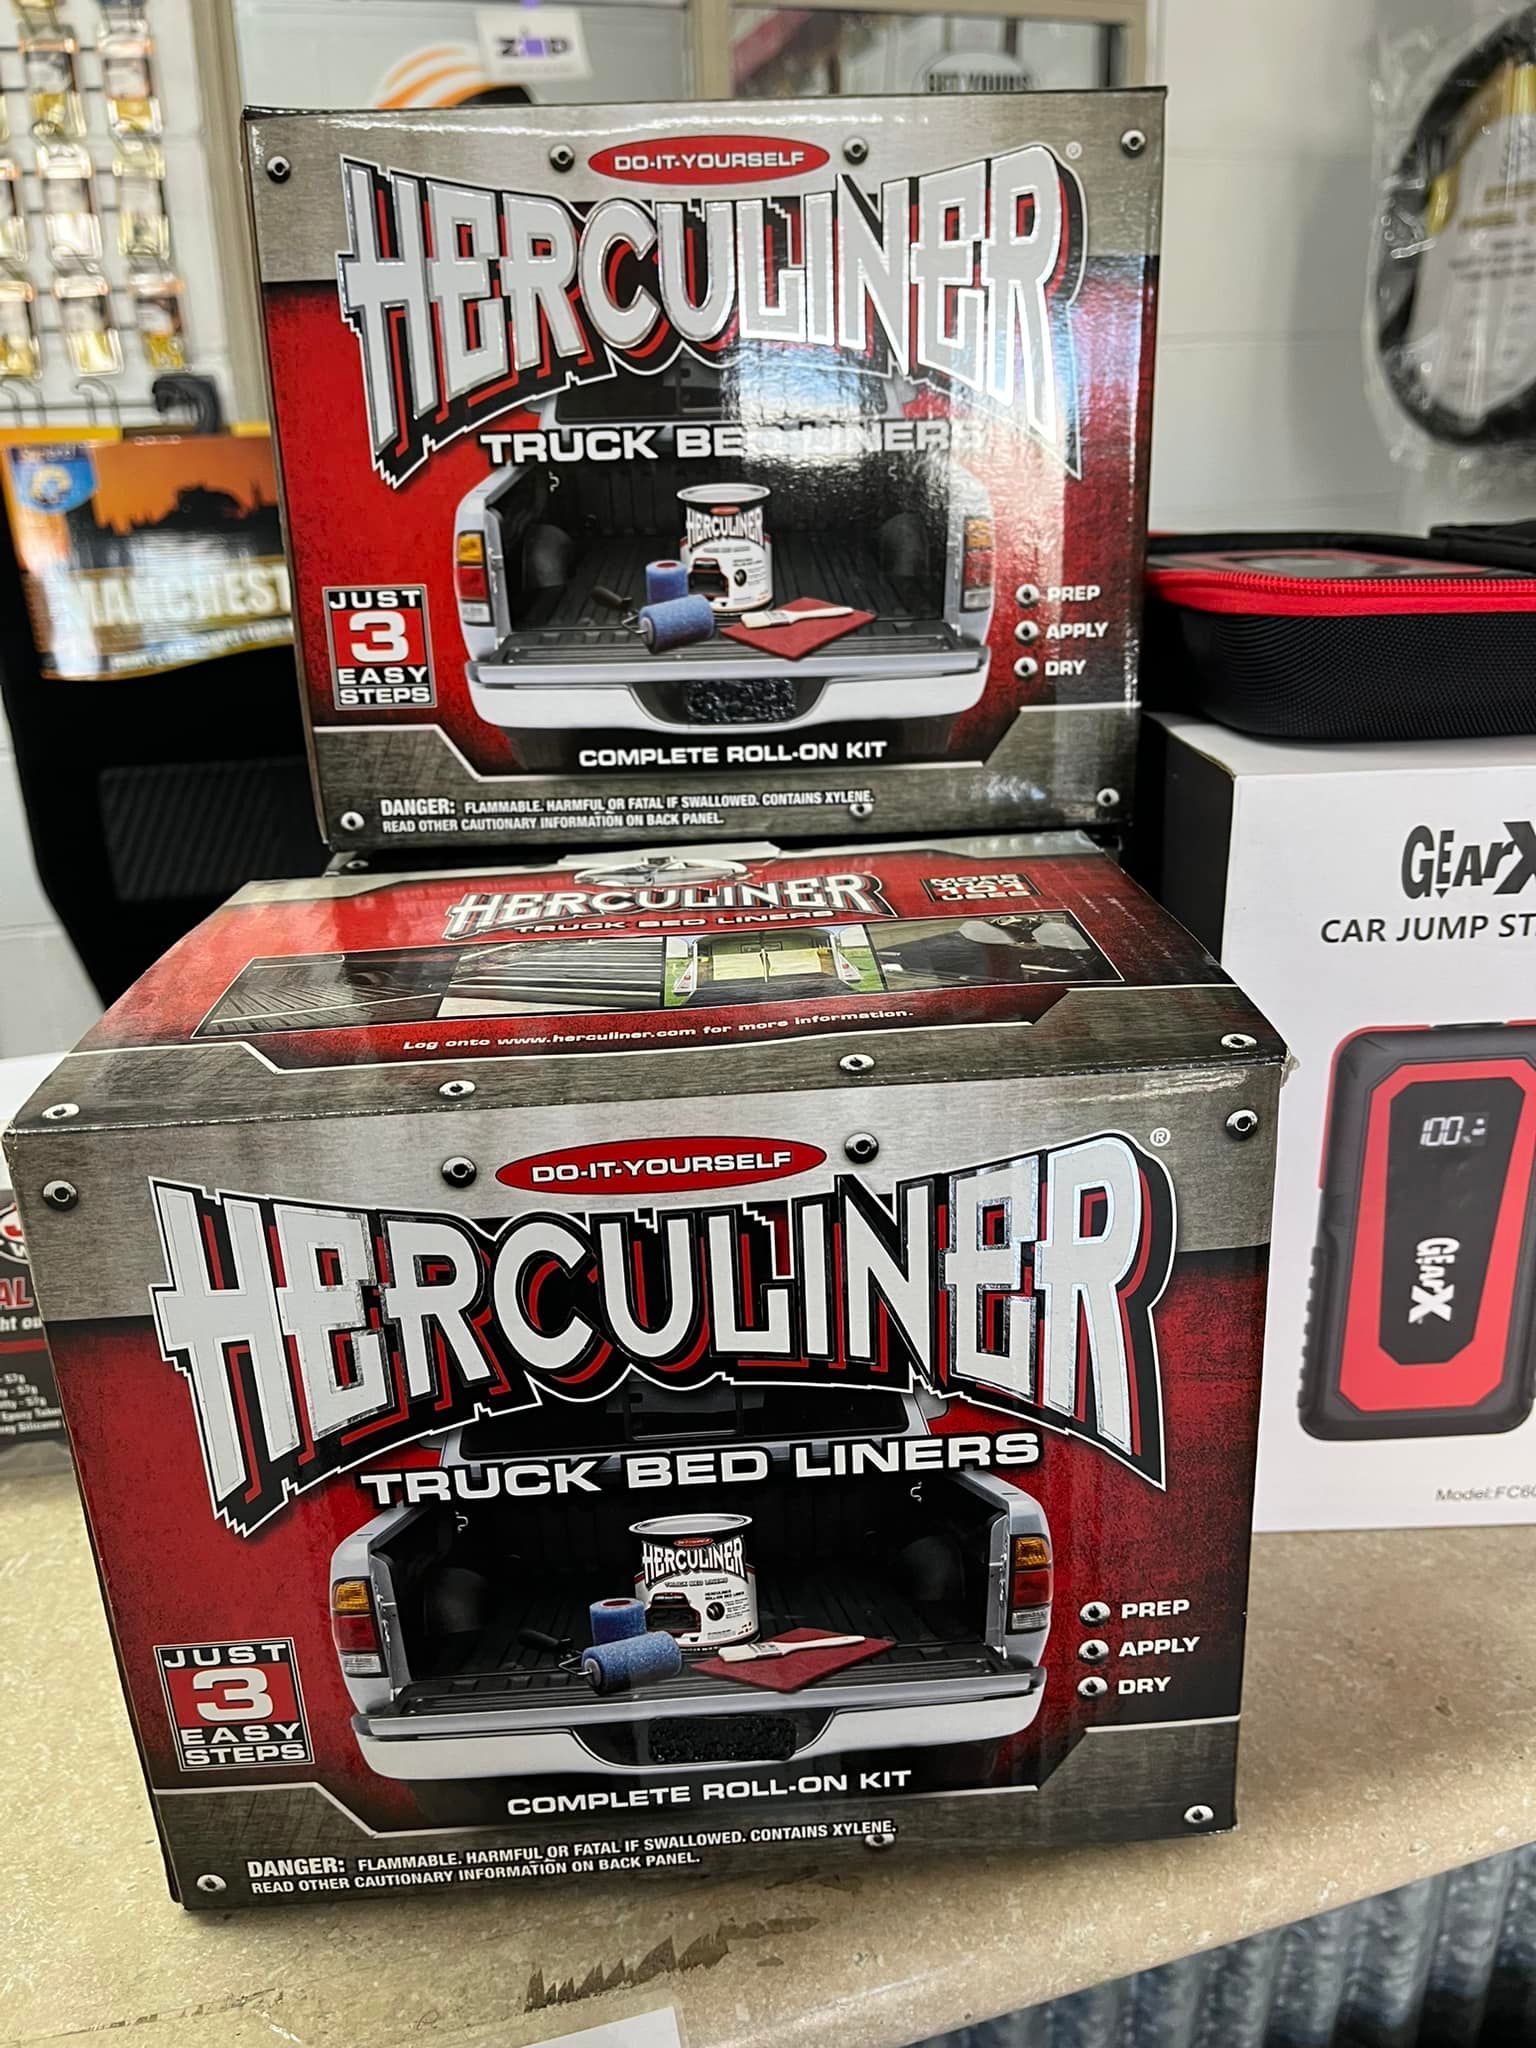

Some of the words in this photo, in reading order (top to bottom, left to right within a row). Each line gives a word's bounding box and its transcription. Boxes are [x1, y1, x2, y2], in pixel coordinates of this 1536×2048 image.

[614, 151, 805, 171] DO-IT-YOURSELF
[337, 144, 1084, 480] HERCULINER
[480, 427, 658, 464] TRUCK
[686, 504, 764, 549] HERCULINER
[329, 589, 421, 610] JUST
[1047, 585, 1101, 602] PREP
[349, 610, 410, 662] 3
[1046, 621, 1109, 640] APPLY
[337, 666, 428, 685] EASY
[1045, 659, 1087, 677] DRY
[340, 687, 430, 705] STEPS
[579, 746, 719, 767] COMPLETE
[726, 742, 838, 763] ROLL-ON
[846, 740, 888, 759] KIT
[380, 798, 456, 816] DANGER:
[546, 799, 606, 812] HARMFUL
[608, 798, 625, 811] OR
[628, 797, 665, 811] FATAL
[667, 797, 678, 809] IF
[681, 794, 760, 808] SWALLOWED.
[762, 792, 822, 806] CONTAINS
[825, 789, 875, 804] XYLENE.
[382, 819, 416, 832] READ
[418, 818, 459, 832] OTHER
[461, 816, 538, 831] CAUTIONARY
[540, 815, 624, 829] INFORMATION
[626, 814, 644, 827] ON
[646, 813, 679, 826] BACK
[682, 811, 725, 825] PANEL.
[444, 873, 892, 939] HERCULINER
[515, 920, 625, 934] TRUCK
[637, 917, 706, 929] BED
[717, 910, 835, 925] LINERS
[1320, 918, 1387, 943] CAR
[1396, 915, 1489, 942] JUMP
[403, 1040, 439, 1051] Log
[445, 1037, 490, 1047] onto
[497, 1028, 697, 1046] www.herculiner.com
[703, 1024, 732, 1035] for
[738, 1019, 789, 1031] more
[795, 1009, 914, 1026] information.
[531, 1151, 792, 1183] DO-IT-YOURSELF
[149, 1132, 1170, 1524] HERCULINER
[361, 1460, 603, 1503] TRUCK
[626, 1450, 770, 1489] BED
[795, 1432, 1040, 1478] LINERS
[642, 1537, 746, 1588] HERCULINER
[1121, 1599, 1190, 1619] PREP
[163, 1643, 287, 1668] JUST
[1118, 1636, 1201, 1657] APPLY
[192, 1667, 274, 1722] 3
[1118, 1676, 1171, 1694] DRY
[180, 1722, 301, 1745] EASY
[184, 1743, 306, 1765] STEPS
[507, 1785, 691, 1815] COMPLETE
[703, 1774, 848, 1801] ROLL-ON
[860, 1770, 912, 1789] KIT
[248, 1857, 345, 1878] DANGER:
[358, 1852, 463, 1871] FLAMMABLE.
[466, 1847, 543, 1864] HARMFUL
[547, 1844, 570, 1859] OR
[574, 1841, 621, 1856] FATAL
[624, 1839, 640, 1852] IF
[643, 1830, 747, 1850] SWALLOWED.
[750, 1824, 828, 1842] CONTAINS
[832, 1819, 897, 1836] XYLENE.
[251, 1880, 295, 1895] READ
[299, 1876, 350, 1891] OTHER
[354, 1869, 453, 1888] CAUTIONARY
[458, 1862, 568, 1881] INFORMATION
[572, 1860, 595, 1873] ON
[599, 1856, 642, 1870] BACK
[646, 1852, 701, 1867] PANEL.
